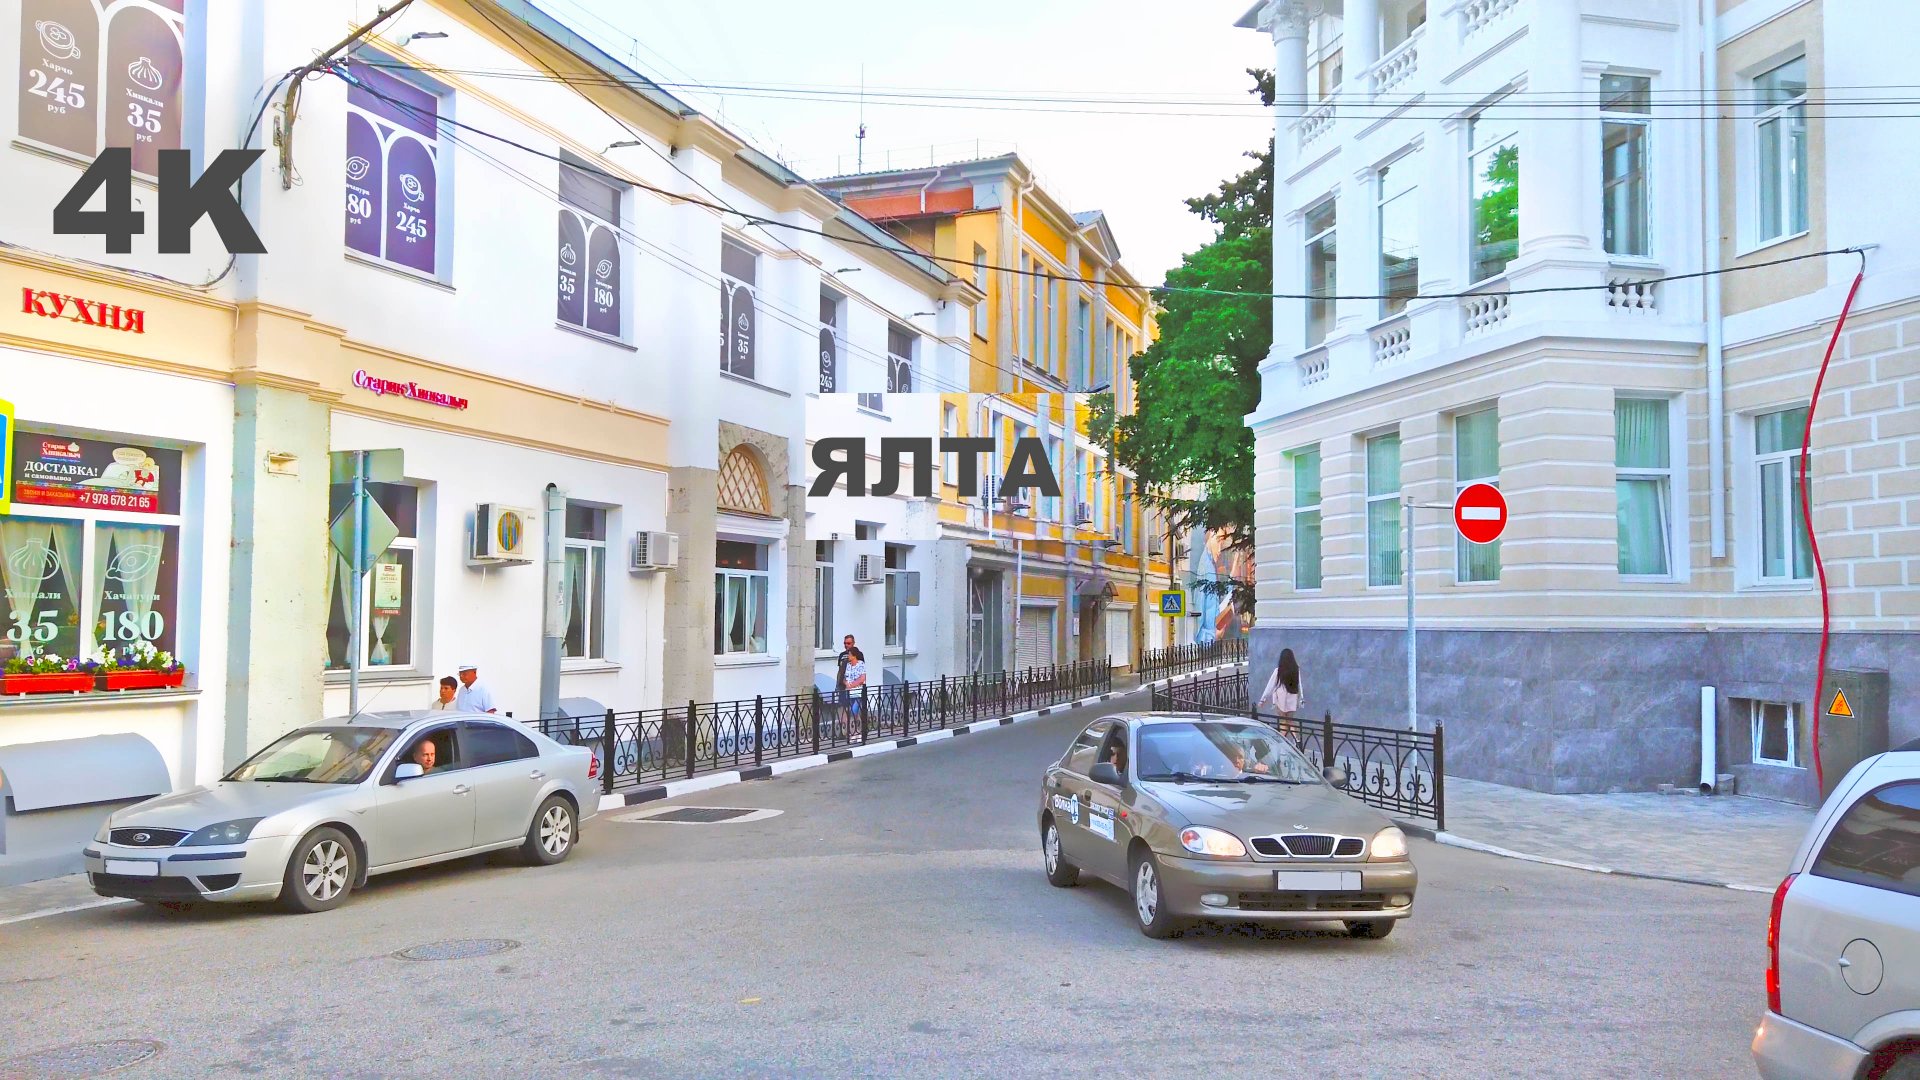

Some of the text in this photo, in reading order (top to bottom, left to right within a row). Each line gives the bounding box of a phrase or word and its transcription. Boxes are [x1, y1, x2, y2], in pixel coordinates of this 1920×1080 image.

[42, 58, 73, 75] Харчо
[28, 68, 85, 109] 245
[47, 104, 66, 114] руб
[127, 102, 162, 133] 35
[345, 193, 372, 219] 80
[395, 210, 427, 238] 245
[560, 274, 576, 295] 35
[593, 287, 614, 308] 180
[22, 287, 145, 334] КУХНЯ
[737, 338, 749, 354] 35
[24, 460, 98, 477] ДОСТАВКА!
[79, 492, 150, 508] +7 978 678 21 65
[6, 609, 59, 642] 35
[102, 610, 164, 641] 180
